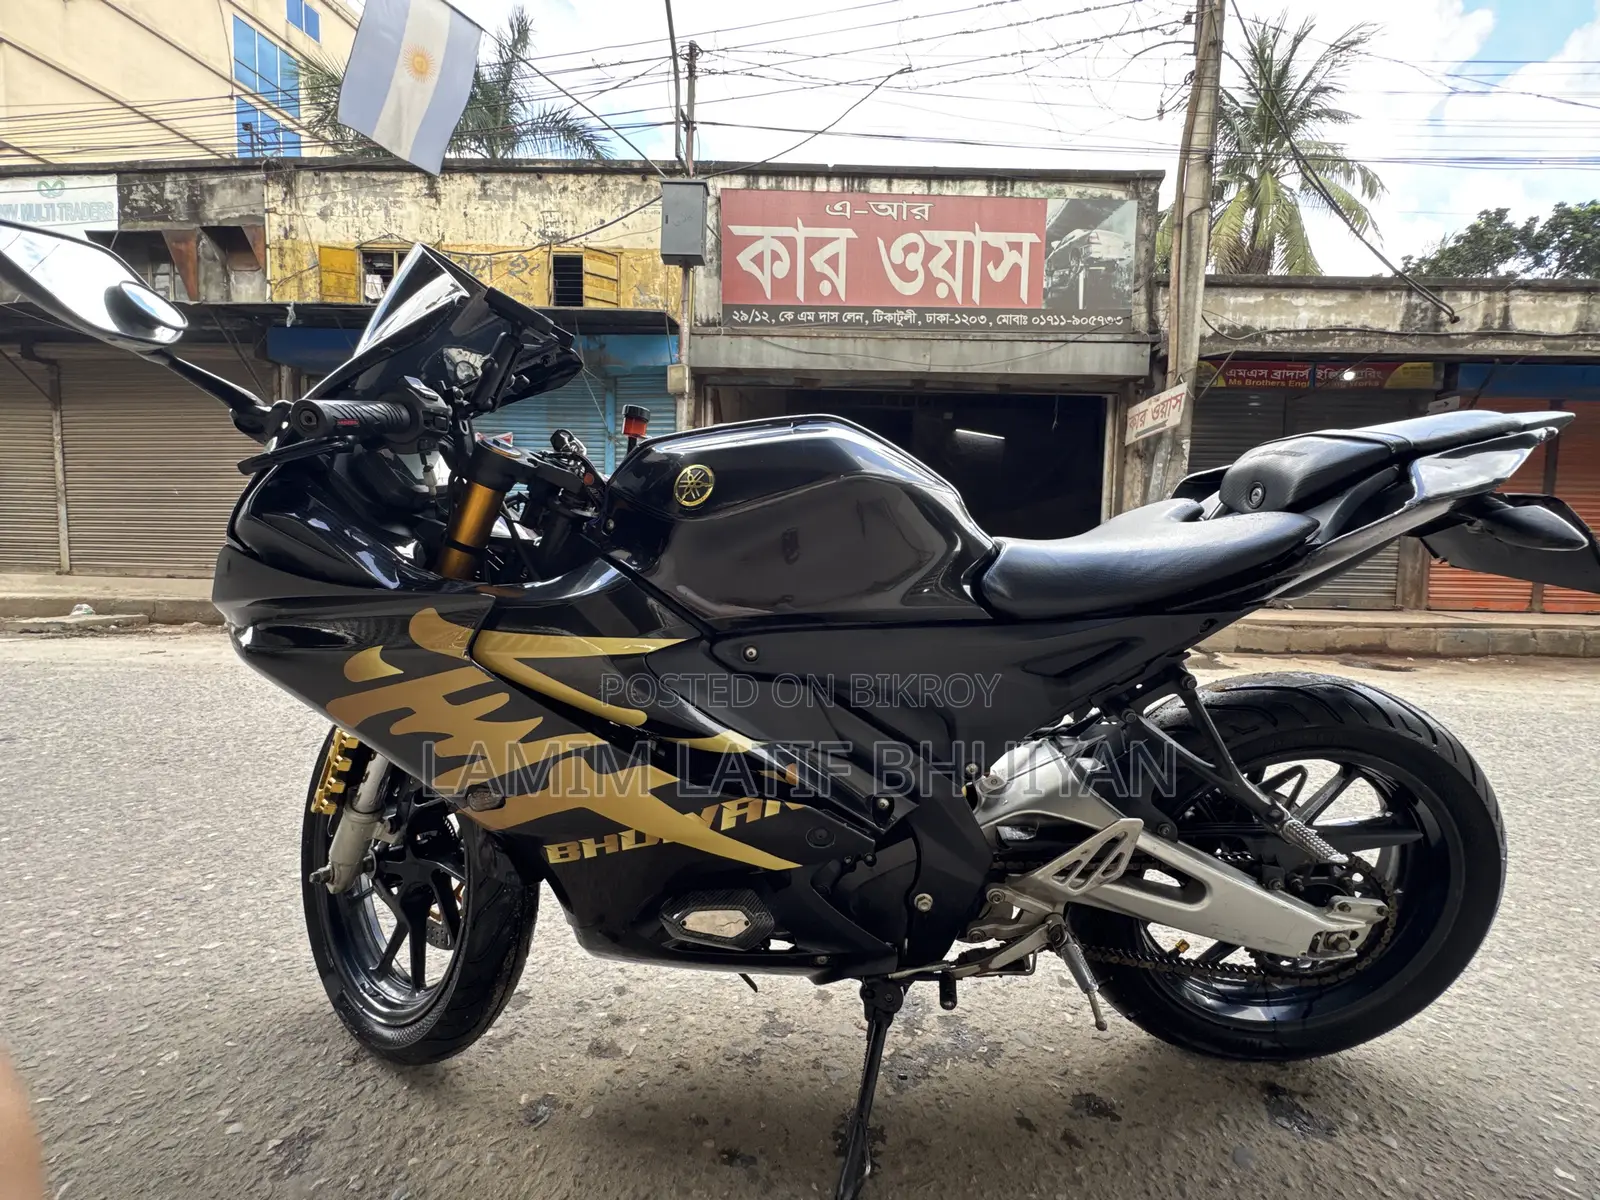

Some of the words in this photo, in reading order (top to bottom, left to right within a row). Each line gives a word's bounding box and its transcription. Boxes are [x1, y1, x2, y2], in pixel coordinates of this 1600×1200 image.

[57, 201, 115, 221] TRADERS
[825, 200, 935, 221] এ-আর
[727, 216, 858, 303] কার
[877, 221, 1042, 306] ওয়াস
[779, 310, 795, 322] কে
[797, 310, 816, 323] এম
[818, 310, 839, 323] দাস
[1245, 378, 1286, 387] Brothers
